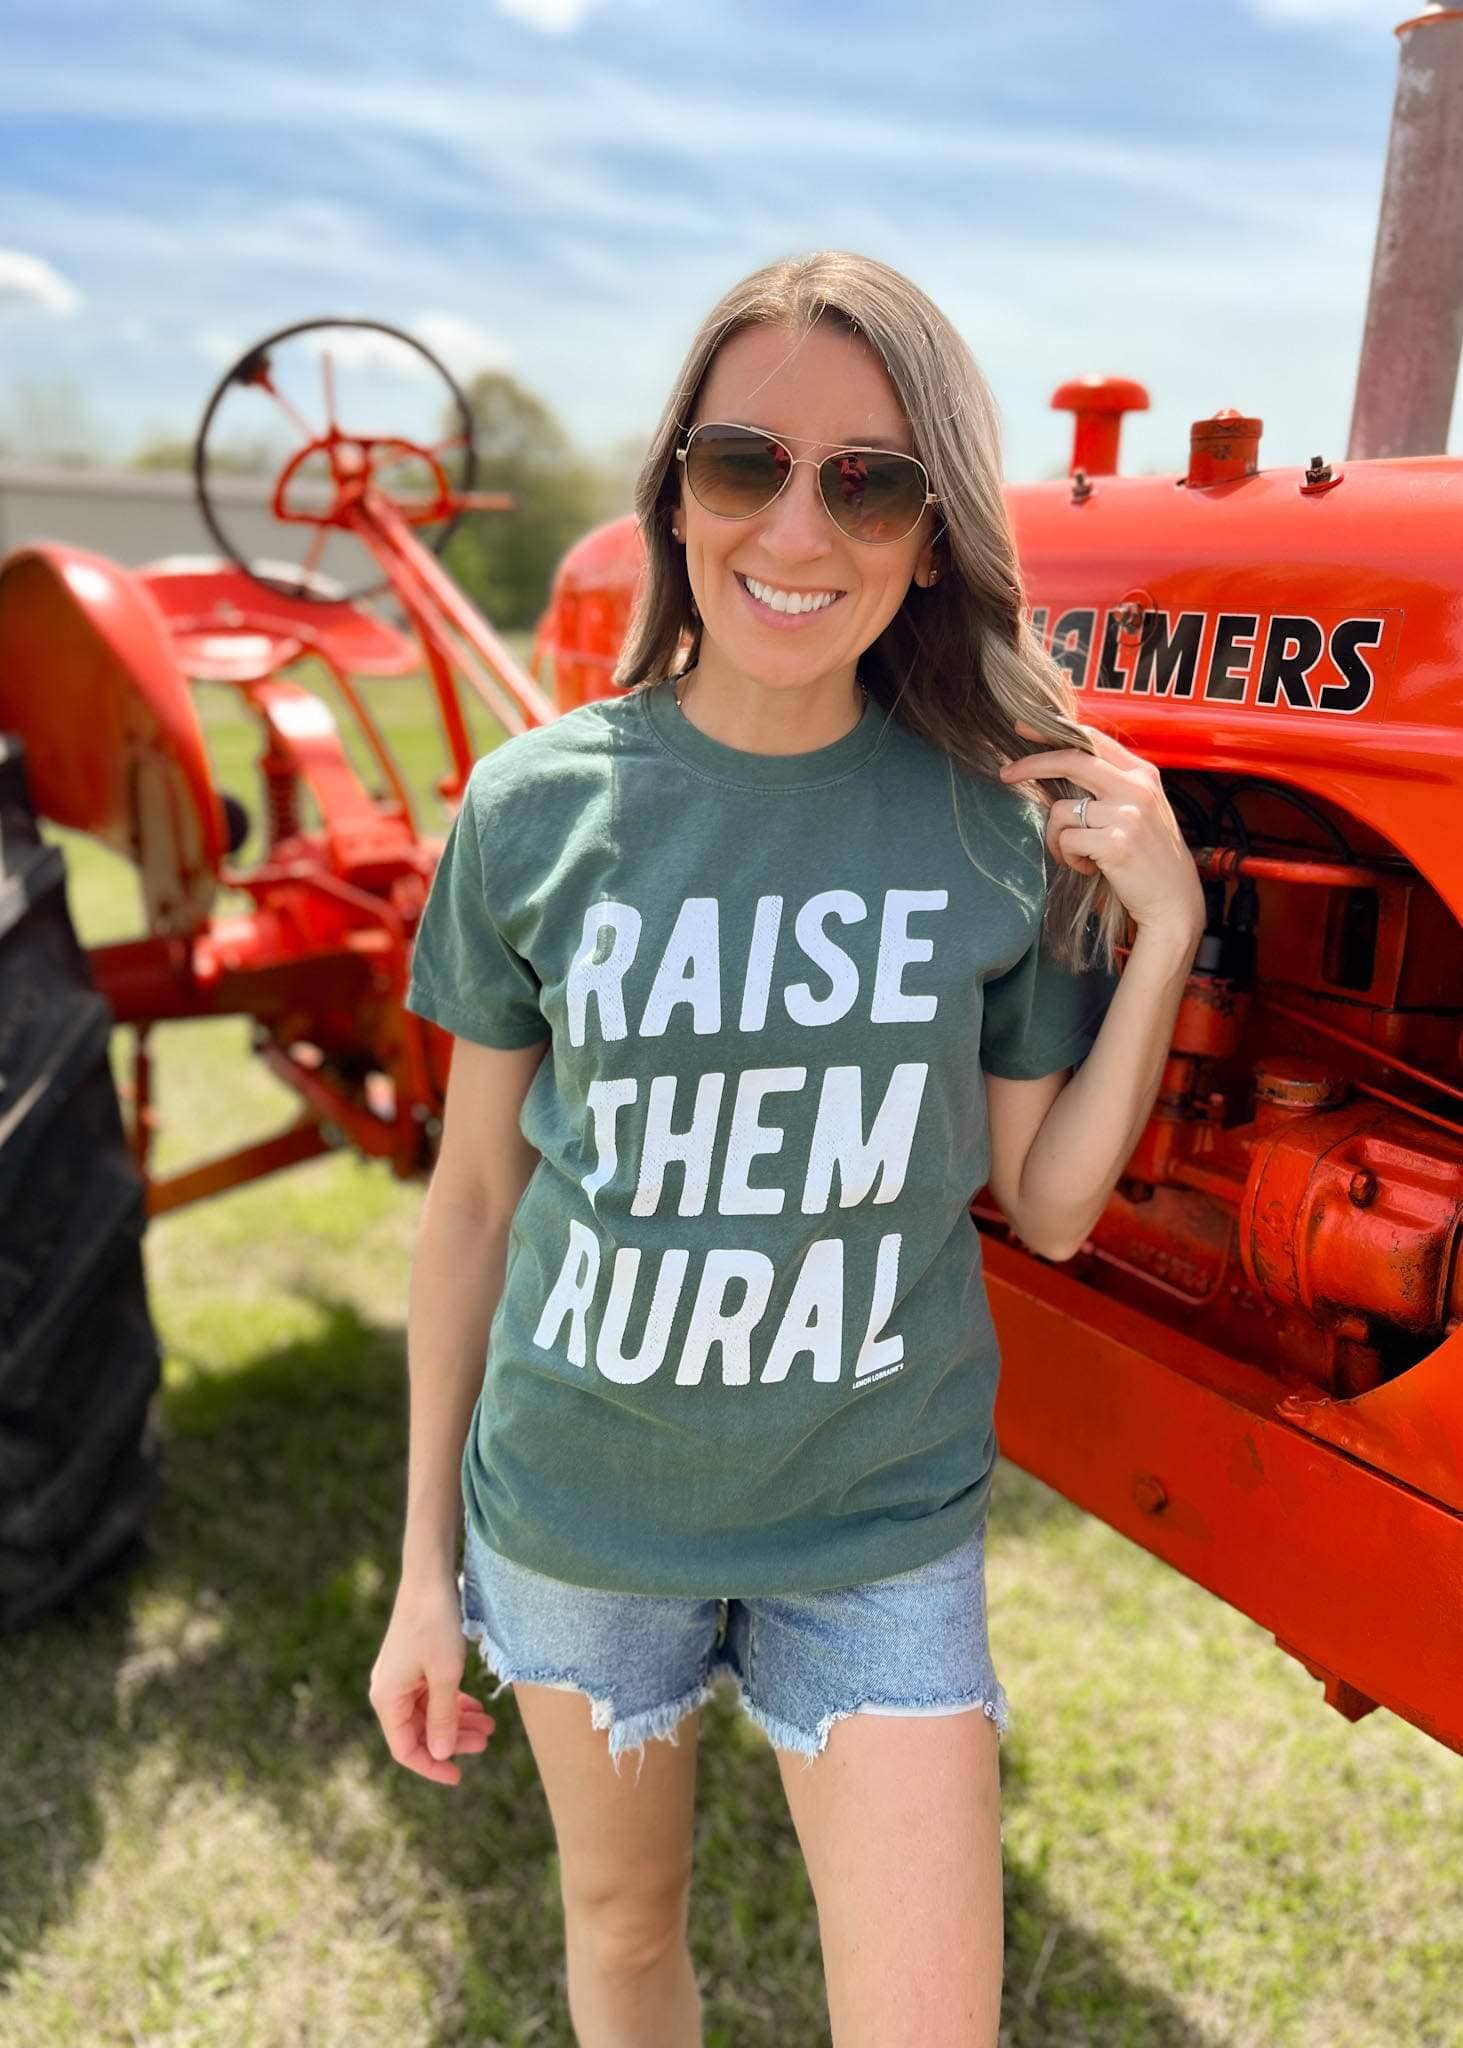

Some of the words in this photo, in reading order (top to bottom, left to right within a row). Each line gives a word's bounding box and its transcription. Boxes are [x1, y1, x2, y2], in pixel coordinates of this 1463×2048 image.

[566, 889, 949, 1048] RAISE
[581, 1063, 929, 1217] THEM
[533, 1219, 904, 1386] RURAL
